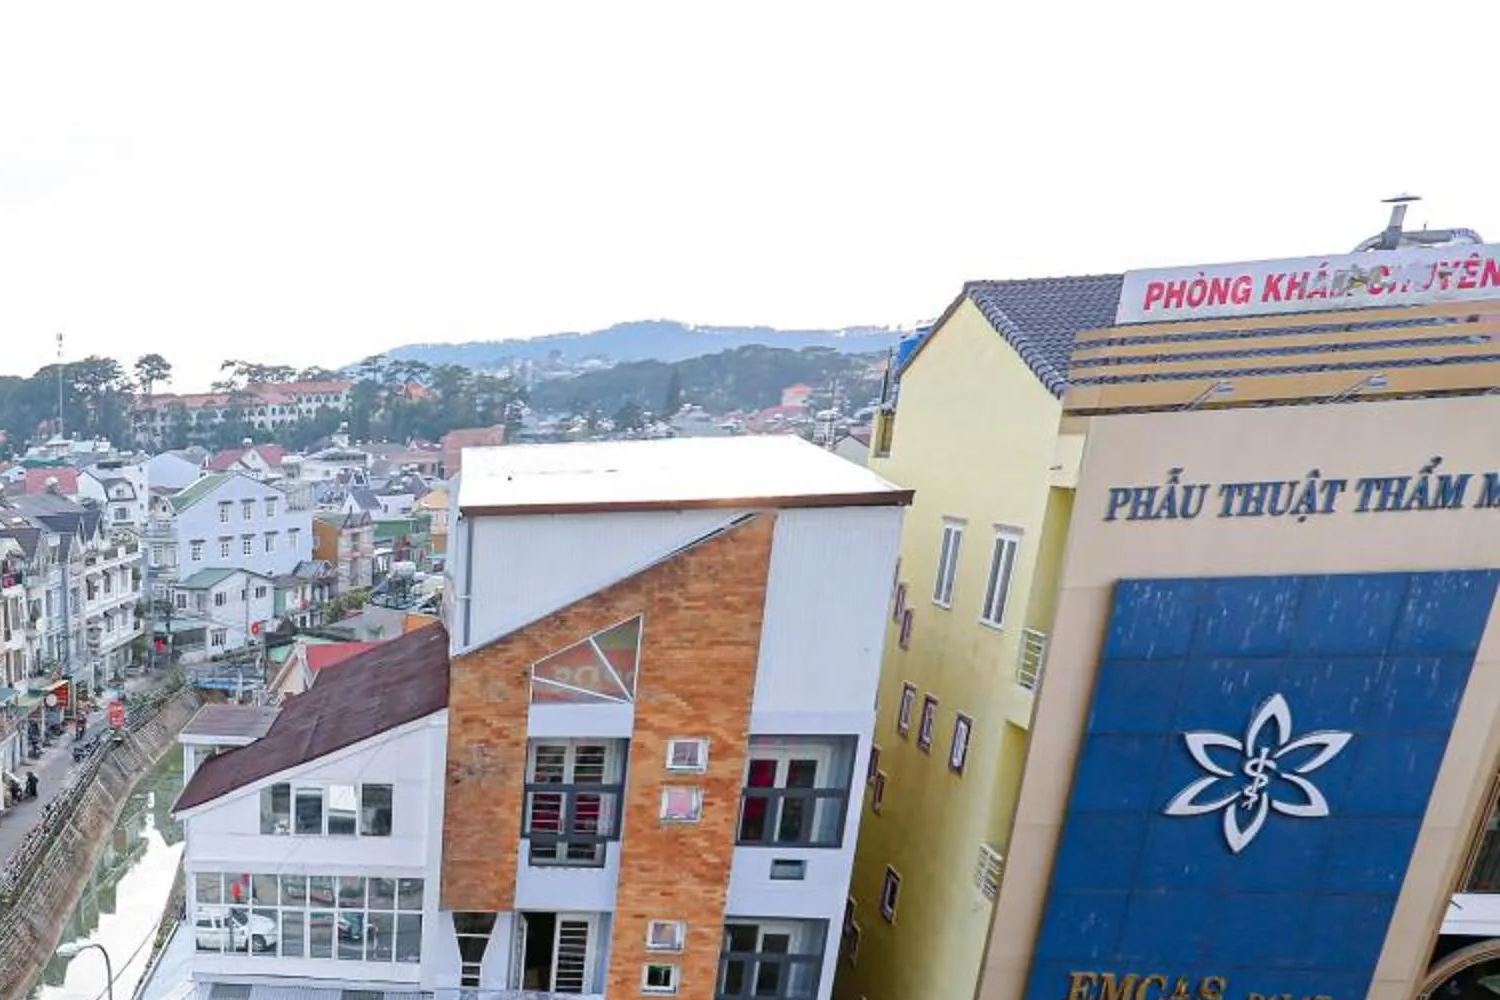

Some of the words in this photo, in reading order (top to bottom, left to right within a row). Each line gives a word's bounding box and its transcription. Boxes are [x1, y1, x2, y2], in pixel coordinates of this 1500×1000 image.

[1143, 272, 1252, 311] PHÒNG
[1103, 467, 1211, 522] PHẪU
[1217, 468, 1348, 523] THUẬT
[1354, 456, 1475, 513] THẨM
